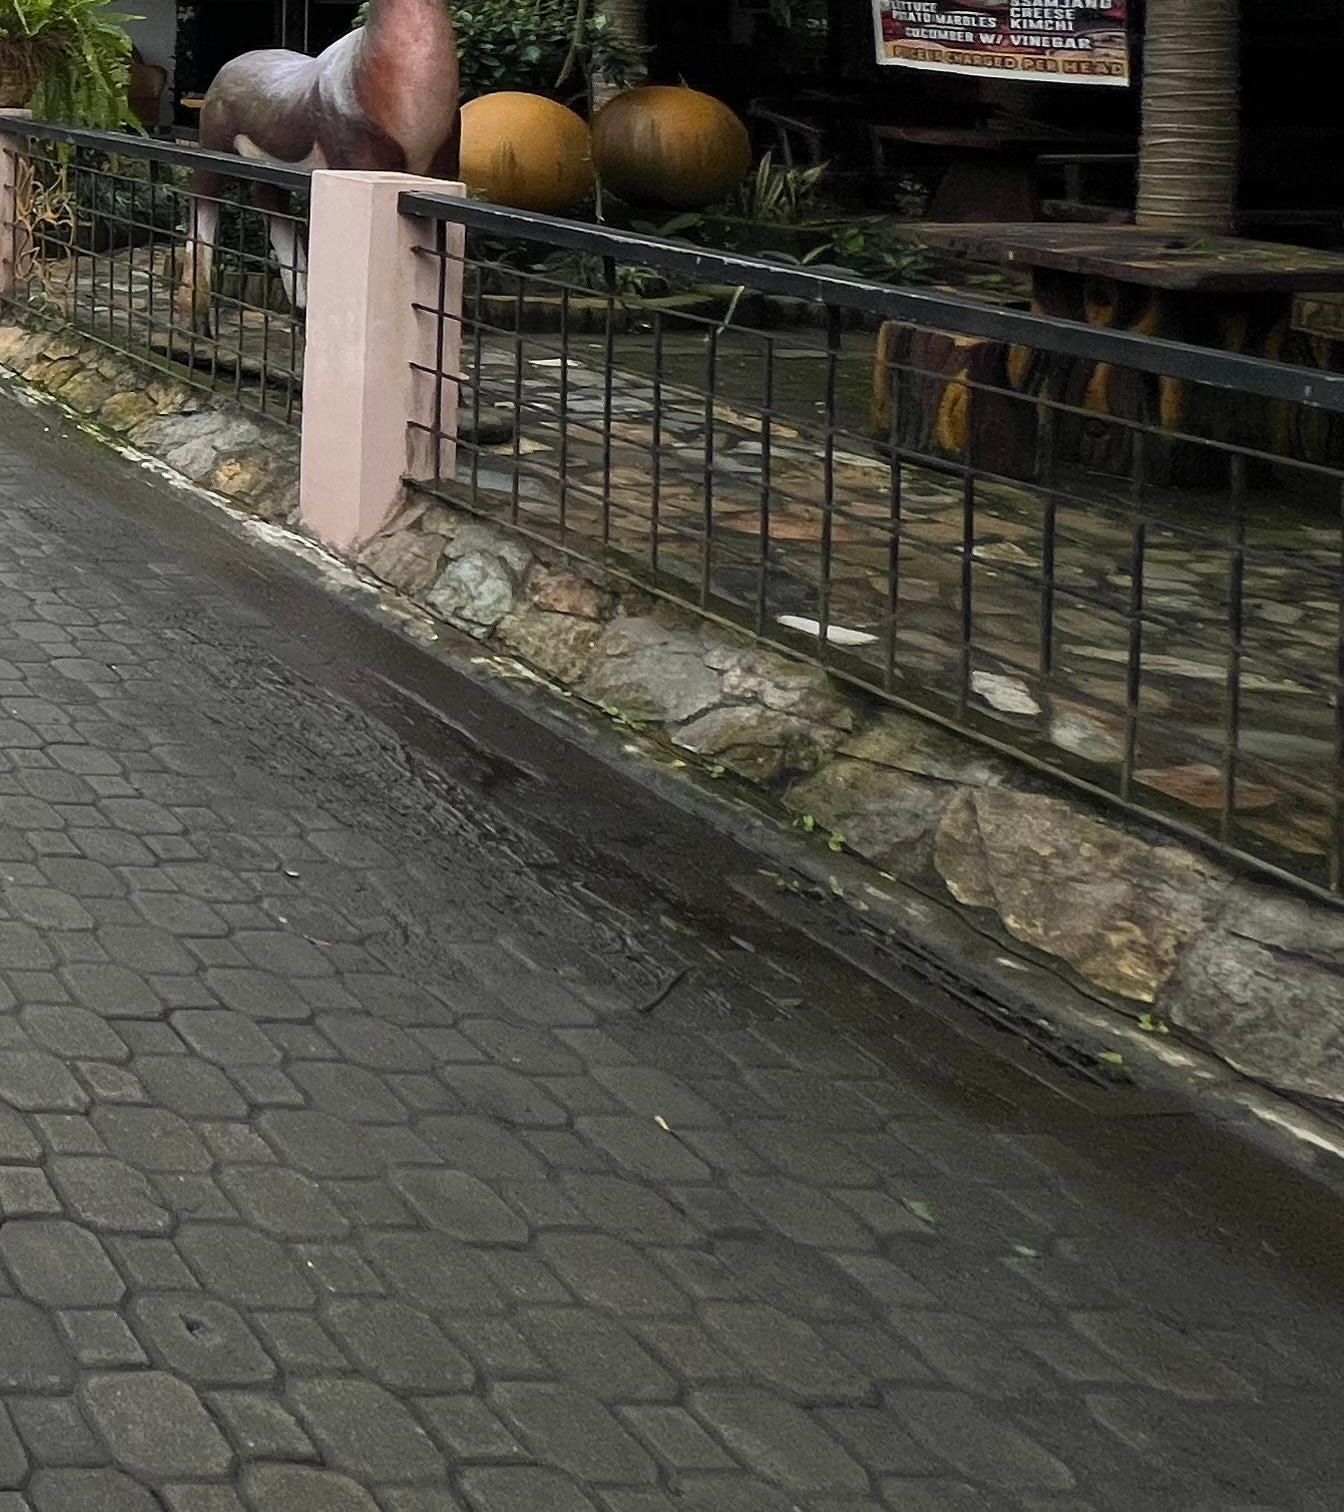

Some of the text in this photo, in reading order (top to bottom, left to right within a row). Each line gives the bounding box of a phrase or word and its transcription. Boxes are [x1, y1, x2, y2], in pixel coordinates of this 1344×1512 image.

[935, 14, 997, 28] MARBLES
[1010, 8, 1076, 20] CHEESE
[1010, 19, 1074, 31] KIMCHI
[905, 26, 1093, 49] CUCUMBER W/ VINEGAR
[944, 50, 1019, 68] CHARGED
[1021, 56, 1059, 73] PER
[1062, 58, 1124, 76] HEAD
